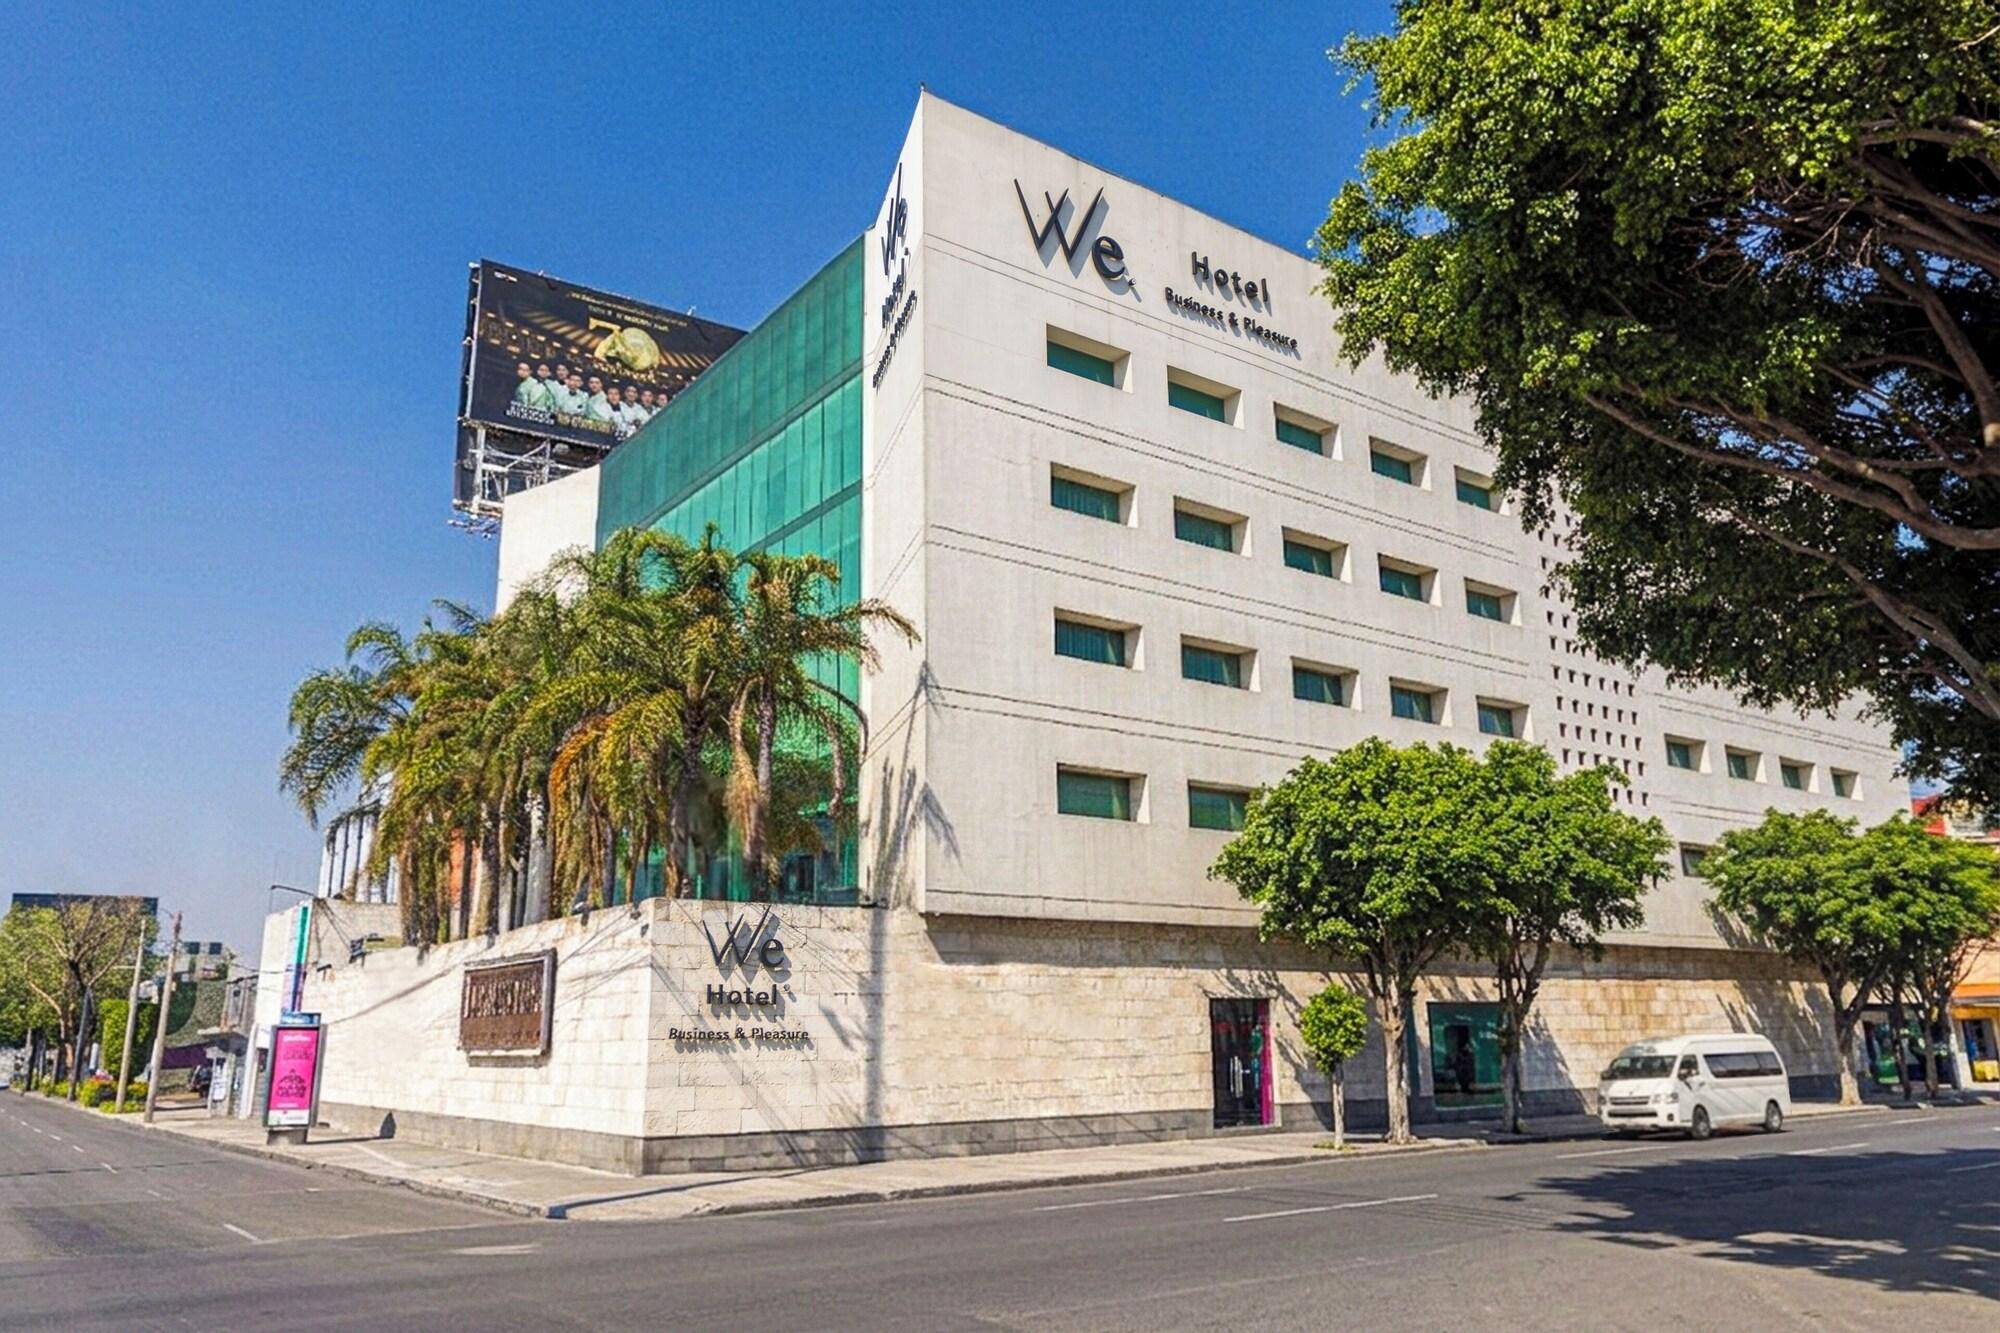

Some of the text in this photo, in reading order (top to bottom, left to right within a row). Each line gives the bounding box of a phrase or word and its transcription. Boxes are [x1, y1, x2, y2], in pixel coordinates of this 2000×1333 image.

[1013, 178, 1126, 279] We
[1192, 251, 1269, 303] Hotel
[1165, 286, 1298, 349] Business & Pleasure
[703, 904, 785, 968] We
[706, 984, 777, 1006] Hotel
[669, 1027, 809, 1040] Business & Pleasure
